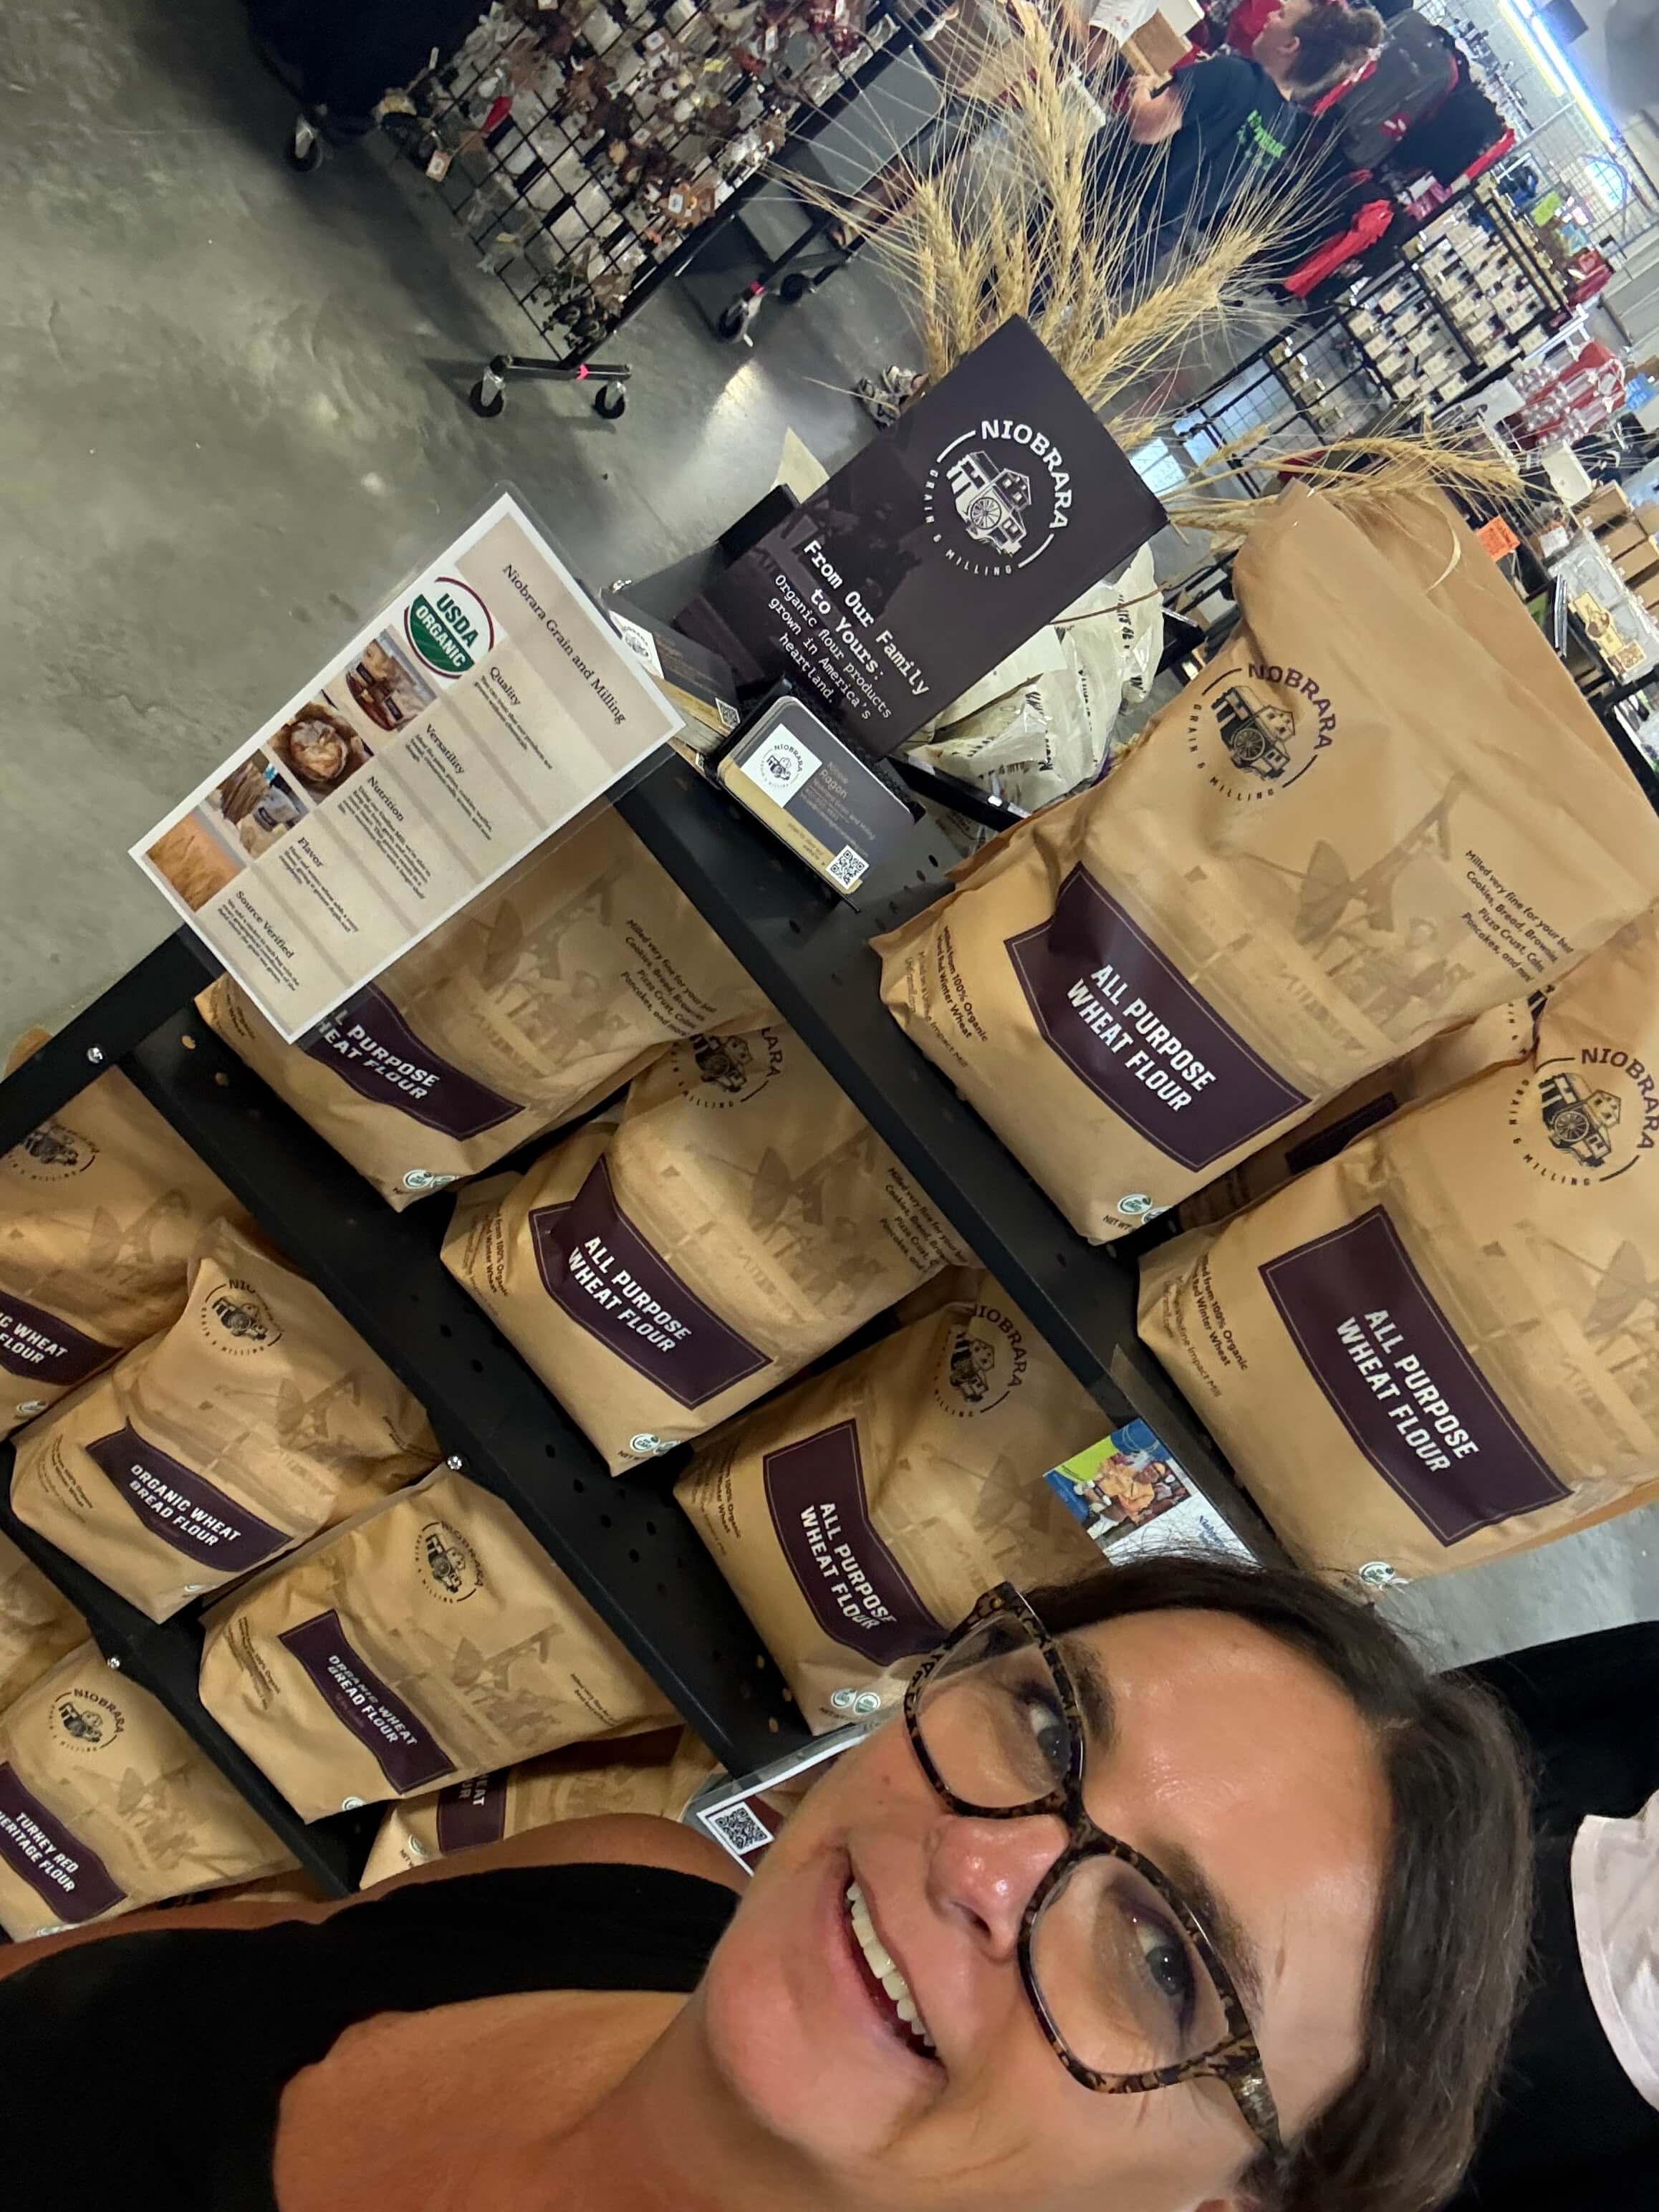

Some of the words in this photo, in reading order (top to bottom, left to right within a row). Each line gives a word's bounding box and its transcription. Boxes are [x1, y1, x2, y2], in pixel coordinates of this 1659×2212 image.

[982, 418, 1072, 527] NIOBRARA
[923, 470, 937, 523] GRAIN
[944, 548, 1010, 577] MILLING
[413, 604, 467, 668] ORGANIC
[433, 592, 482, 649] USDA
[501, 563, 549, 620] Niobrara
[543, 617, 577, 657] Grain
[570, 653, 595, 680] and
[589, 678, 629, 726] Milling
[772, 572, 819, 629] Organic
[817, 627, 847, 661] flour
[840, 662, 893, 720] products
[802, 539, 847, 590] From
[842, 589, 878, 629] Our
[873, 629, 932, 698] Family
[807, 587, 835, 616] to
[832, 616, 886, 681] Yours:
[487, 665, 523, 708] Quality
[766, 596, 803, 635] grown
[801, 635, 821, 656] in
[817, 655, 874, 721] America's
[777, 633, 838, 704] heartland.
[1249, 661, 1335, 750] NOBRARA
[423, 723, 466, 776] Versatility
[774, 744, 803, 774] NIOBRARA
[1188, 704, 1202, 752] GRAIN
[1208, 776, 1274, 801] MILLING
[366, 775, 406, 822] Nutrition
[297, 837, 325, 870] Flavor
[234, 890, 264, 924] Source
[261, 920, 295, 959] Verified
[1463, 849, 1492, 877] Milled
[1487, 875, 1507, 896] very
[1504, 890, 1524, 910] fine
[1522, 906, 1541, 923] for
[1534, 919, 1559, 941] your
[1464, 870, 1497, 908] Cookies,
[1494, 903, 1526, 932] Bread,
[625, 918, 652, 943] Milled
[646, 941, 665, 962] very
[673, 973, 689, 989] for
[683, 986, 703, 1006] your
[1460, 910, 1503, 956] Pancakes,
[1501, 951, 1520, 968] and
[1477, 907, 1501, 931] Pizza
[1499, 928, 1527, 956] Crust,
[620, 969, 656, 1012] Pancakes,
[652, 1009, 670, 1026] and
[636, 967, 658, 992] Pizza
[653, 988, 677, 1016] Crust,
[937, 972, 953, 1006] Winter
[948, 1004, 971, 1039] Wheat
[951, 973, 968, 1002] 100%
[961, 1000, 990, 1043] Organic
[346, 1021, 441, 1087] PURPOSE
[1064, 977, 1134, 1054] WHEAT
[1122, 1049, 1194, 1113] FLOUR
[1088, 963, 1130, 1007] ALL
[1121, 996, 1217, 1092] PURPOSE
[362, 1055, 429, 1100] FLOUR
[1582, 1047, 1659, 1148] NIOBRARA
[1509, 1079, 1530, 1124] GRAIN
[1522, 1153, 1590, 1187] MILLING
[1102, 1213, 1119, 1226] NET
[486, 1263, 499, 1294] Wheat
[496, 1262, 511, 1297] Organic
[567, 1245, 624, 1310] WHEAT
[616, 1307, 678, 1353] FLOUR
[582, 1236, 616, 1274] ALL
[610, 1268, 693, 1341] PURPOSE
[0, 1331, 46, 1364] FLOUR
[13, 1321, 69, 1357] WHEAT
[1196, 1297, 1213, 1332] Winter
[1208, 1331, 1232, 1367] Wheat
[1202, 1276, 1216, 1302] from
[1209, 1299, 1226, 1329] 100%
[1221, 1327, 1250, 1371] Organic
[1187, 1345, 1211, 1380] Impact
[1206, 1379, 1222, 1398] Mill
[1335, 1315, 1402, 1399] WHEAT
[1387, 1403, 1453, 1473] FLOUR
[1363, 1309, 1405, 1355] ALL
[1393, 1352, 1481, 1460] PURPOSE
[128, 1478, 175, 1518] BREAD
[171, 1514, 221, 1547] FLOUR
[130, 1463, 193, 1512] ORGANIC
[191, 1506, 242, 1542] WHEAT
[716, 1504, 731, 1534] Wheat
[727, 1503, 742, 1539] Organic
[799, 1504, 841, 1577] WHEAT
[830, 1581, 882, 1631] FLOUR
[819, 1501, 844, 1542] ALL
[833, 1542, 898, 1625] PURPOSE
[74, 1688, 126, 1733] NIOBRARA
[326, 1665, 367, 1706] BREAD
[360, 1704, 400, 1744] FLOUR
[327, 1653, 380, 1705] ORGANIC
[378, 1704, 420, 1746] WHEAT
[15, 1811, 58, 1852] TURKEY
[52, 1851, 81, 1875] RED
[38, 1859, 78, 1893] FLOUR
